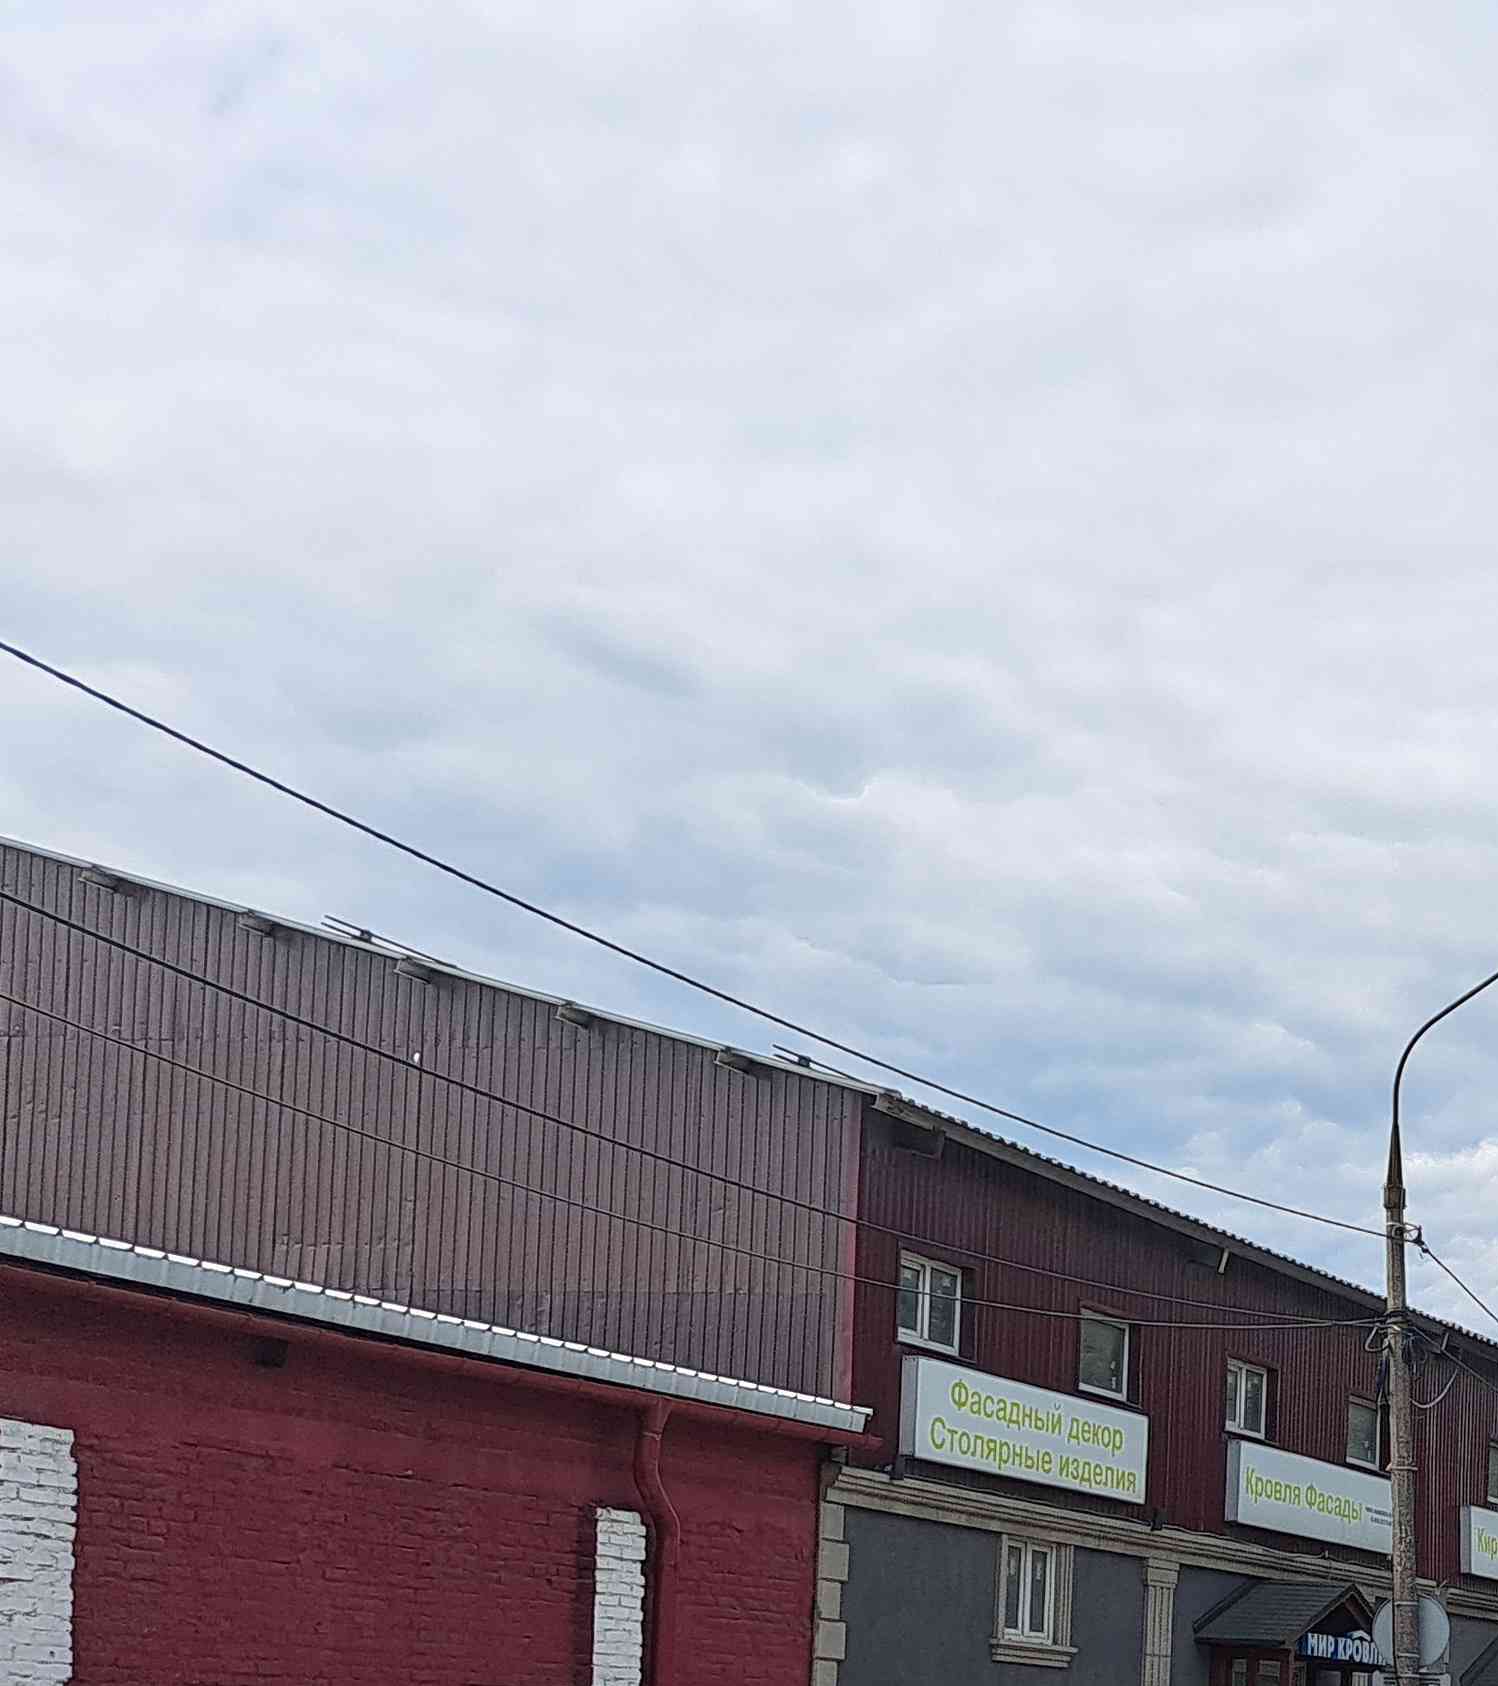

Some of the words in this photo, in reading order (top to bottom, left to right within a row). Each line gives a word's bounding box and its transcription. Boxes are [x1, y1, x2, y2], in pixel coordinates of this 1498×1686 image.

[951, 1379, 1063, 1435] Фасадный
[1067, 1416, 1125, 1456] декор
[929, 1417, 1053, 1474] Столярные
[1058, 1454, 1137, 1494] изделия
[1246, 1468, 1301, 1506] Кровля
[1305, 1483, 1364, 1523] Фасады
[1308, 1633, 1335, 1658] МИР
[1338, 1636, 1387, 1665] КРОВЛ
